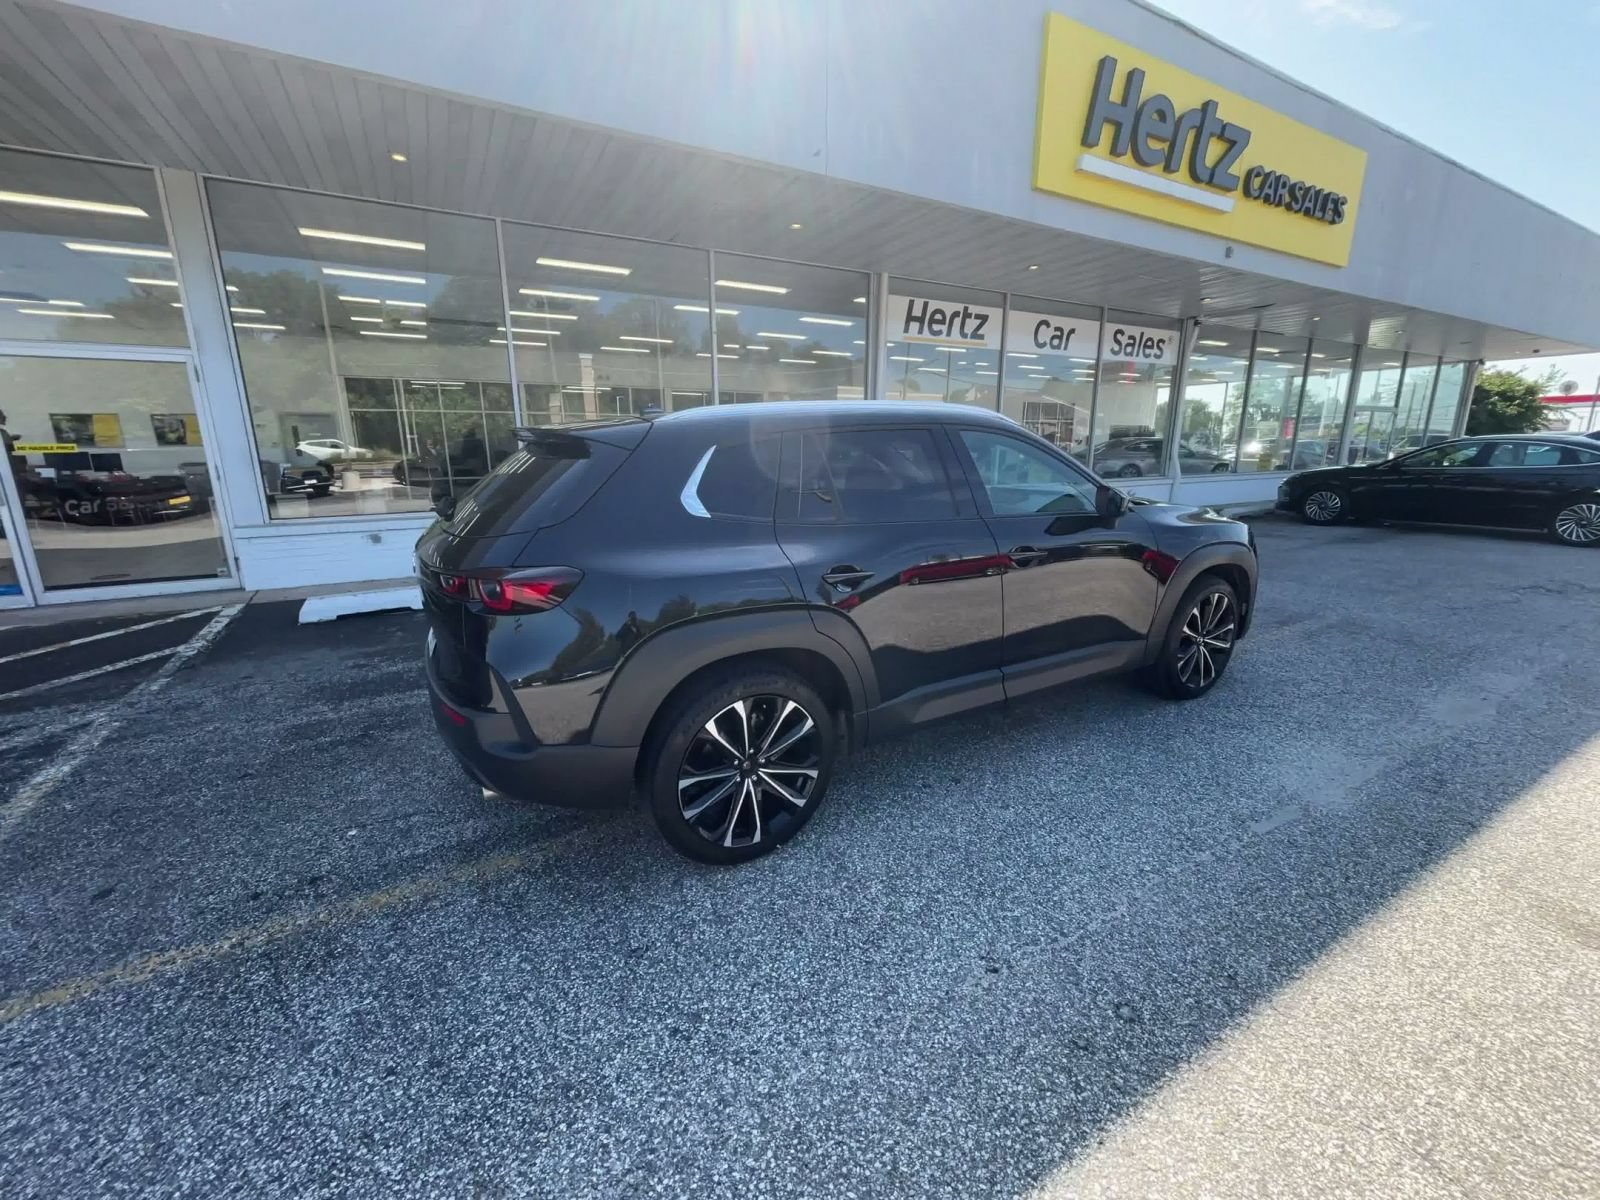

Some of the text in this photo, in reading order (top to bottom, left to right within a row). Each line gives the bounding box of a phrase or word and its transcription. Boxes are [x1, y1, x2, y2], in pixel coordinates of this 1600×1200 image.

[1081, 55, 1252, 192] Hertz
[903, 299, 1166, 360] Hertz Car Sales
[64, 498, 102, 516] Car
